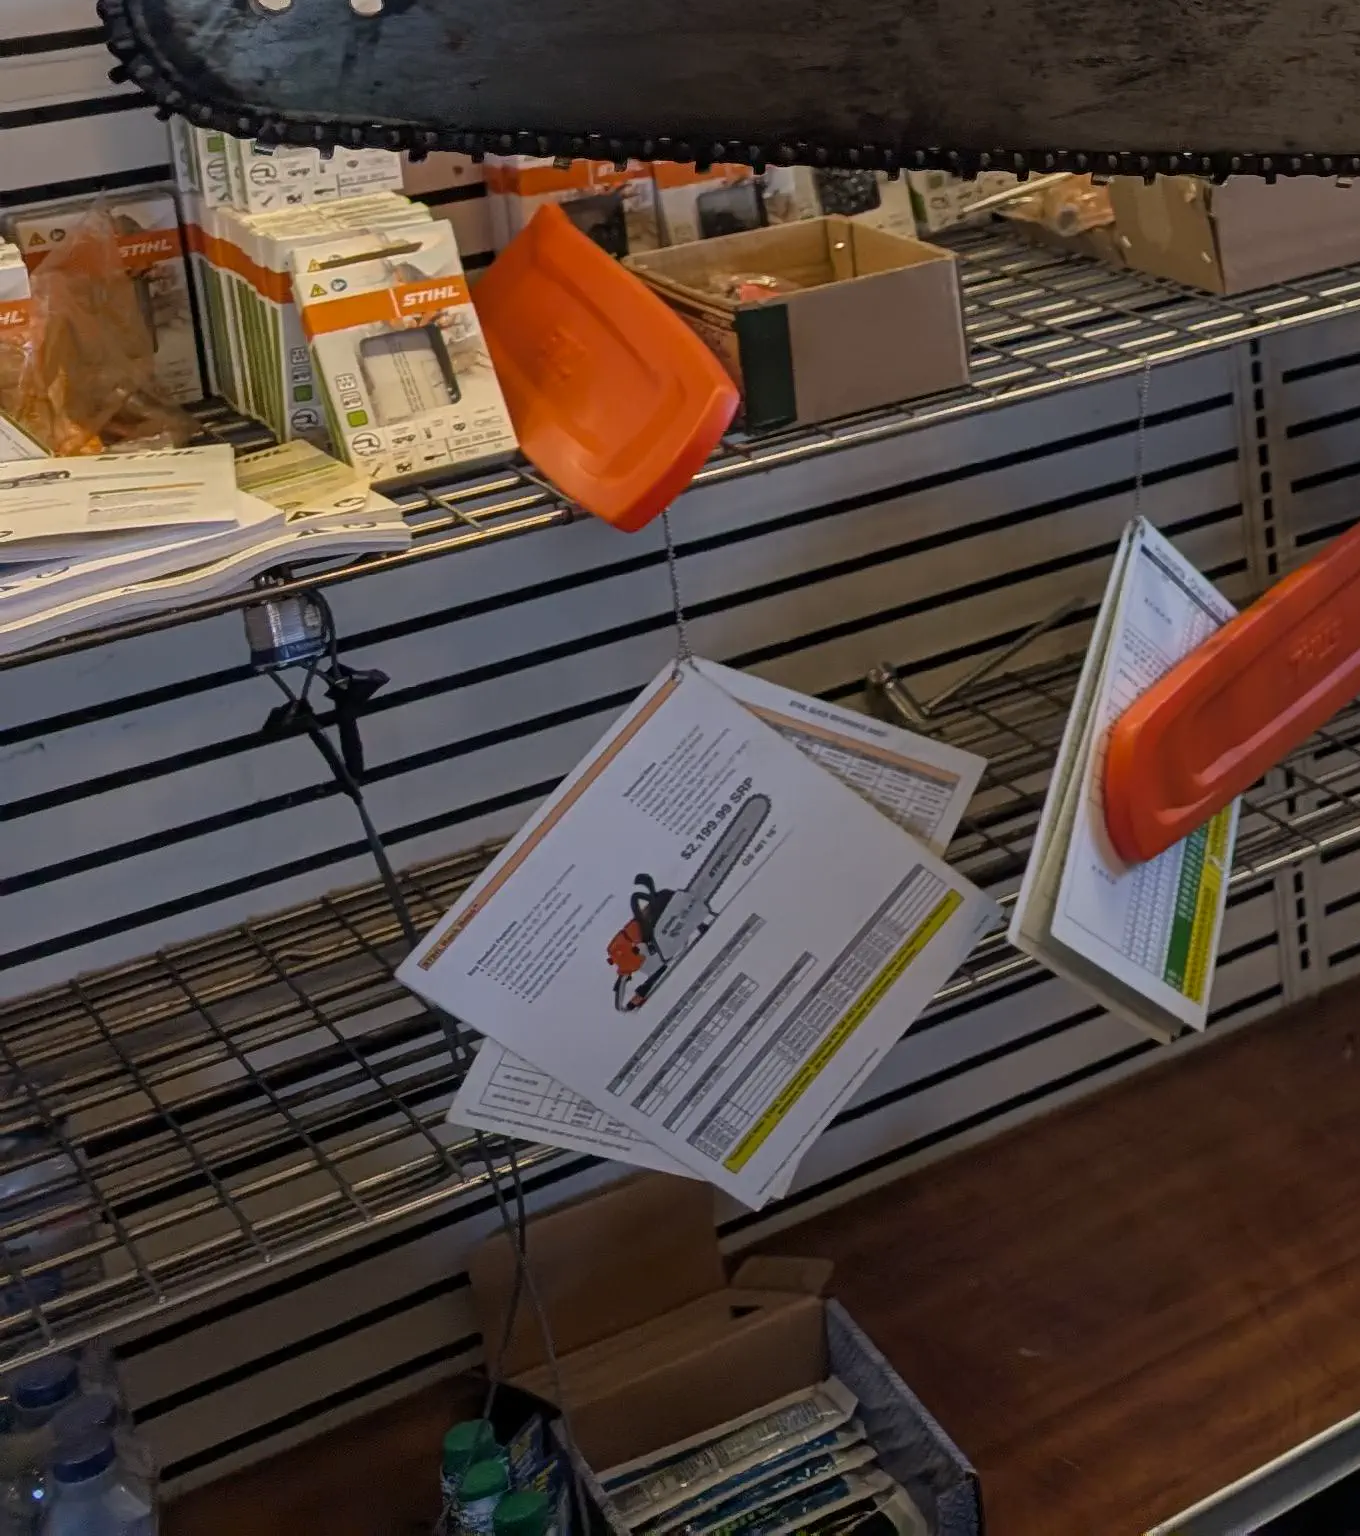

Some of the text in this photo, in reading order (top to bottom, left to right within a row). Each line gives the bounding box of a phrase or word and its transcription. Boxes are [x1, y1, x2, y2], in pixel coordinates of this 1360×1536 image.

[119, 239, 173, 258] STIHL
[402, 284, 461, 307] STIHL
[680, 776, 753, 861] $2,199.99 SRP
